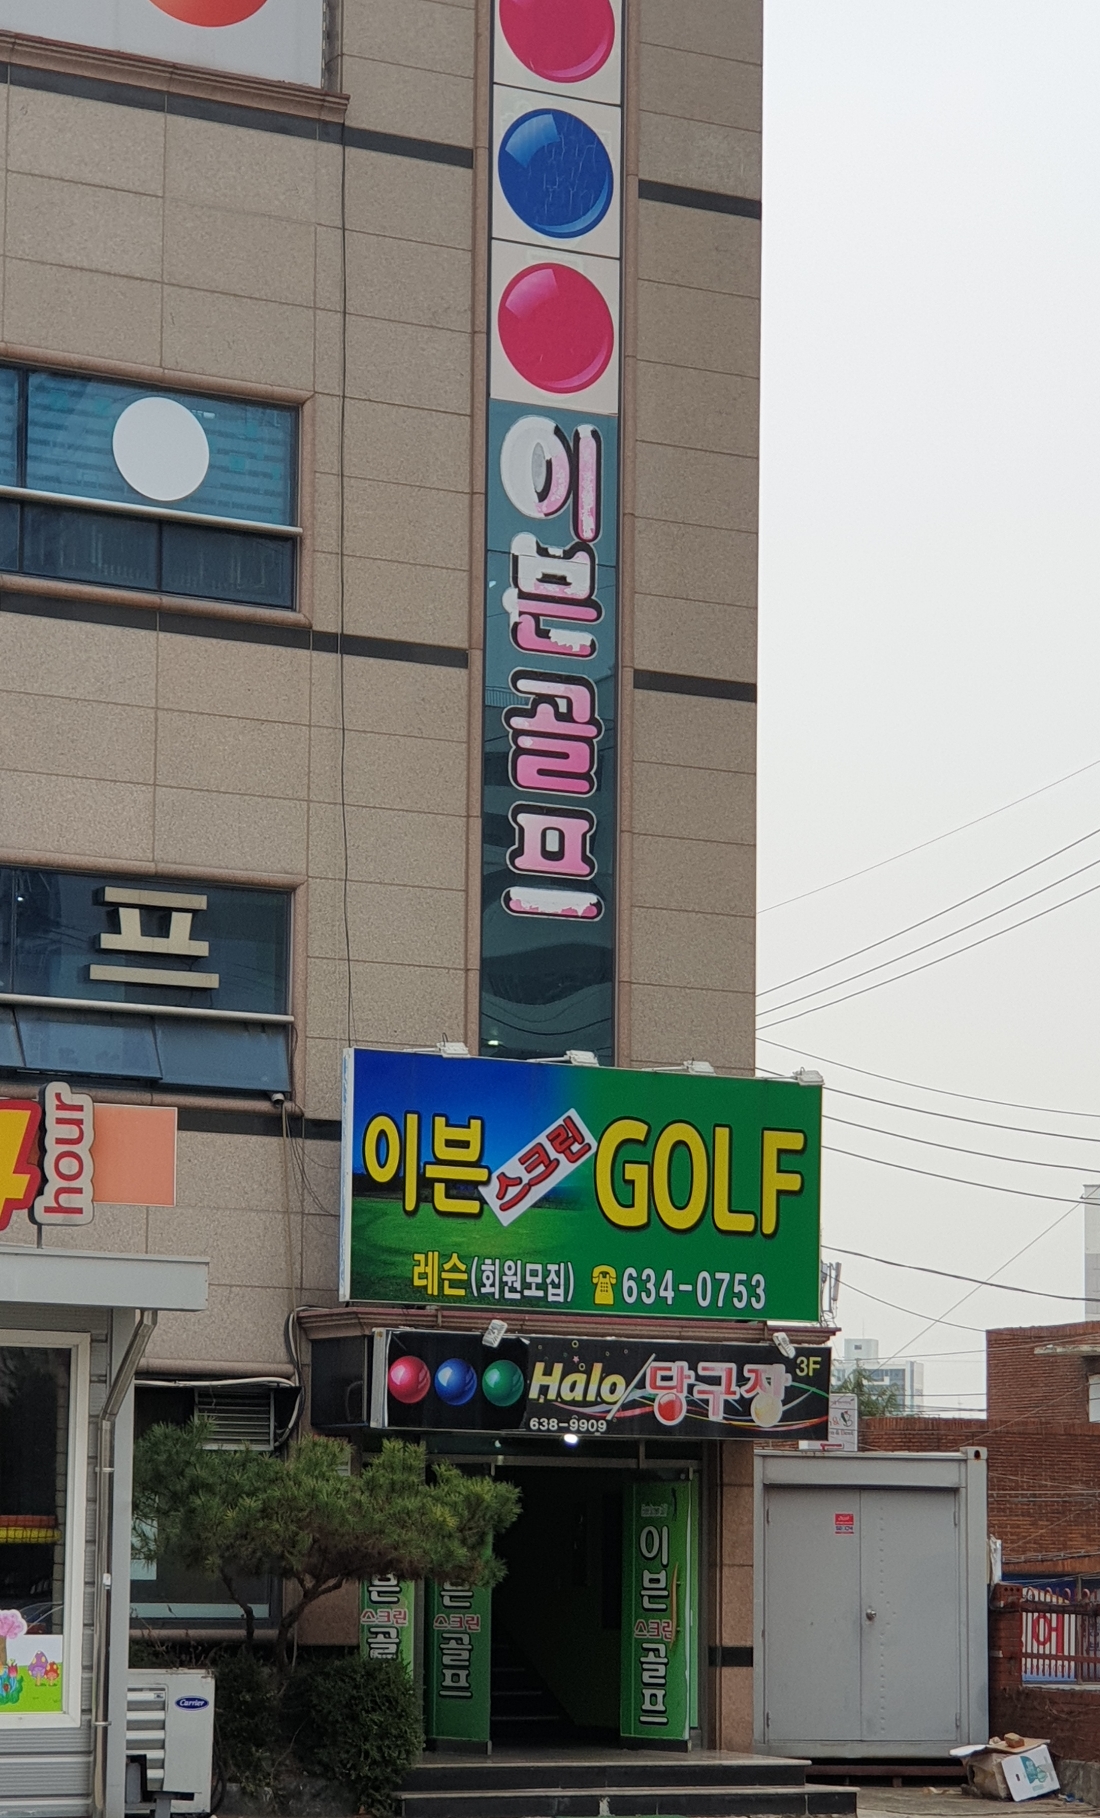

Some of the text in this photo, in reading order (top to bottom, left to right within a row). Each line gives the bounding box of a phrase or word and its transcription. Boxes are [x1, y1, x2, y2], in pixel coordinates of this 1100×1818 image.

[43, 1092, 85, 1215] hour
[362, 1112, 807, 1238] 이븐 스크린 GOLF
[622, 1267, 766, 1310] 634-0753
[528, 1357, 822, 1428] Halo 당구장 3F
[529, 1417, 607, 1433] 638-9909
[361, 1608, 408, 1627] 스크린
[433, 1613, 481, 1632] 스크린
[178, 1698, 205, 1708] Carrier
